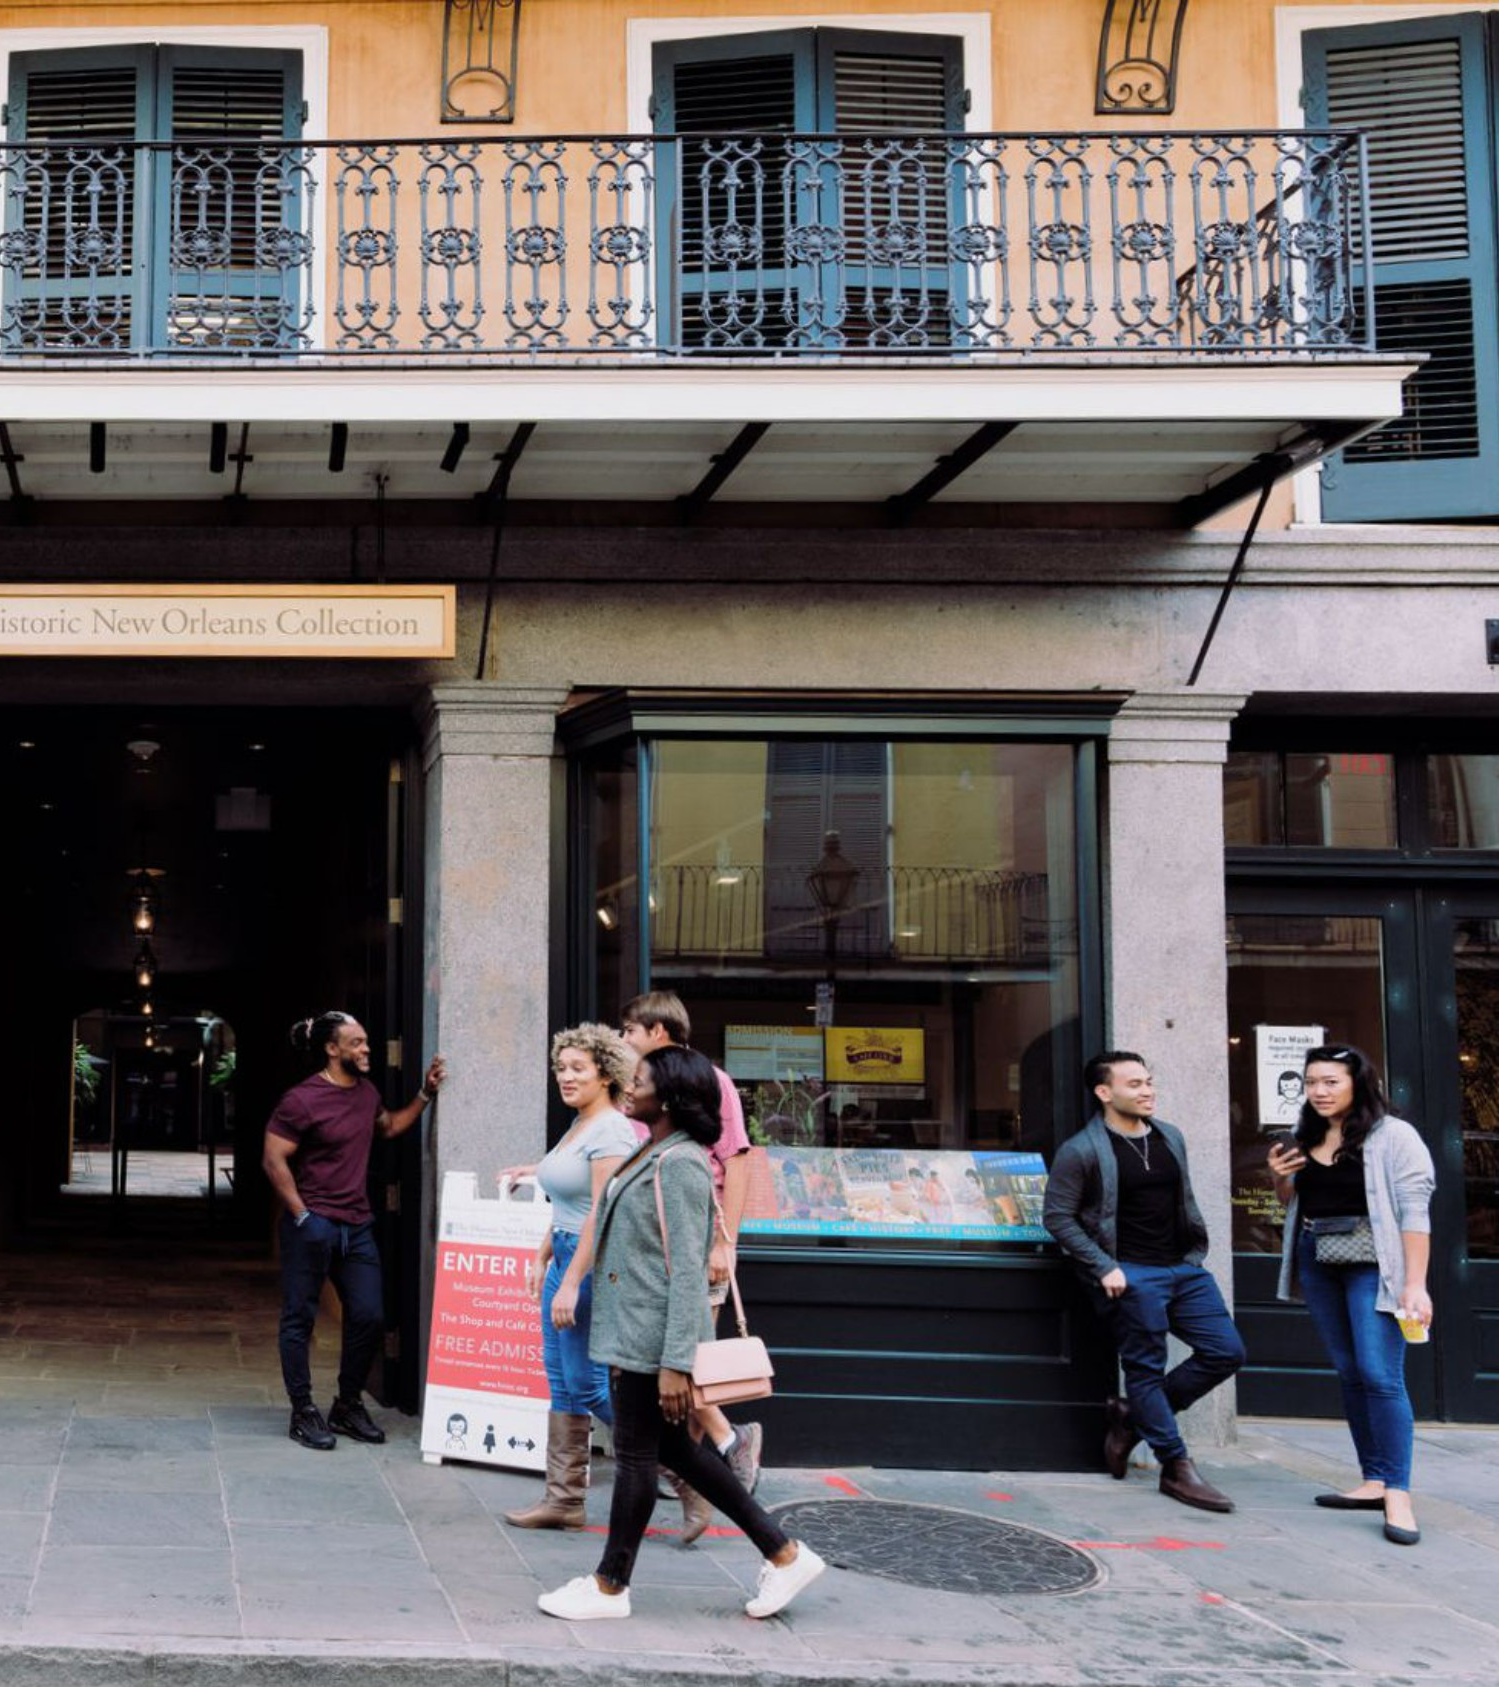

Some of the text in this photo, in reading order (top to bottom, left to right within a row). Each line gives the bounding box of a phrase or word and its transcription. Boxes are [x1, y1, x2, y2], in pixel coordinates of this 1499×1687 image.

[92, 608, 155, 635] New
[161, 608, 267, 635] Orleans
[276, 608, 420, 636] Collection
[1268, 1034, 1314, 1044] Face Masks
[443, 1251, 517, 1276] ENTER
[452, 1282, 494, 1295] Museum
[472, 1297, 542, 1315] Courtyard Ope
[441, 1313, 457, 1323] The
[460, 1314, 484, 1328] Shop
[485, 1318, 503, 1329] and
[528, 1322, 543, 1333] Co
[435, 1334, 545, 1362] FREE ADMISS
